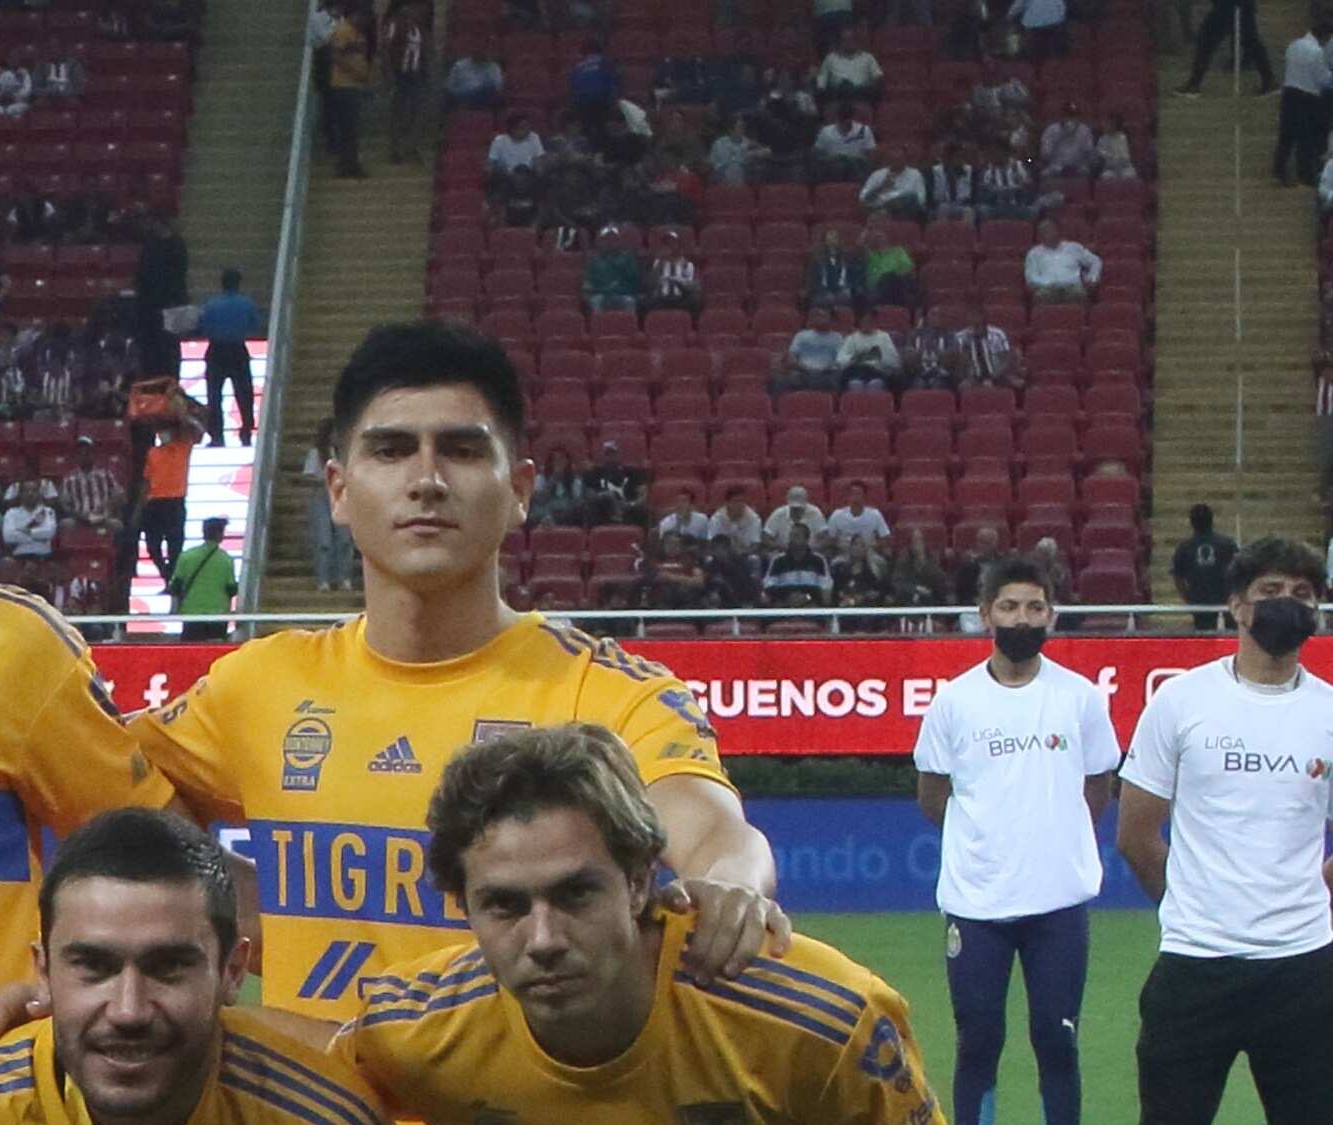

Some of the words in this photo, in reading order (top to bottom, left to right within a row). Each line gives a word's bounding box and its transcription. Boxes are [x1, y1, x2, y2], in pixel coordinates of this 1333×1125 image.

[972, 728, 1004, 742] LIGA
[1204, 735, 1247, 751] LIGA
[988, 734, 1042, 757] BBVA
[368, 760, 422, 774] adidas
[1224, 751, 1300, 774] BBVA
[272, 830, 469, 921] TIGR
